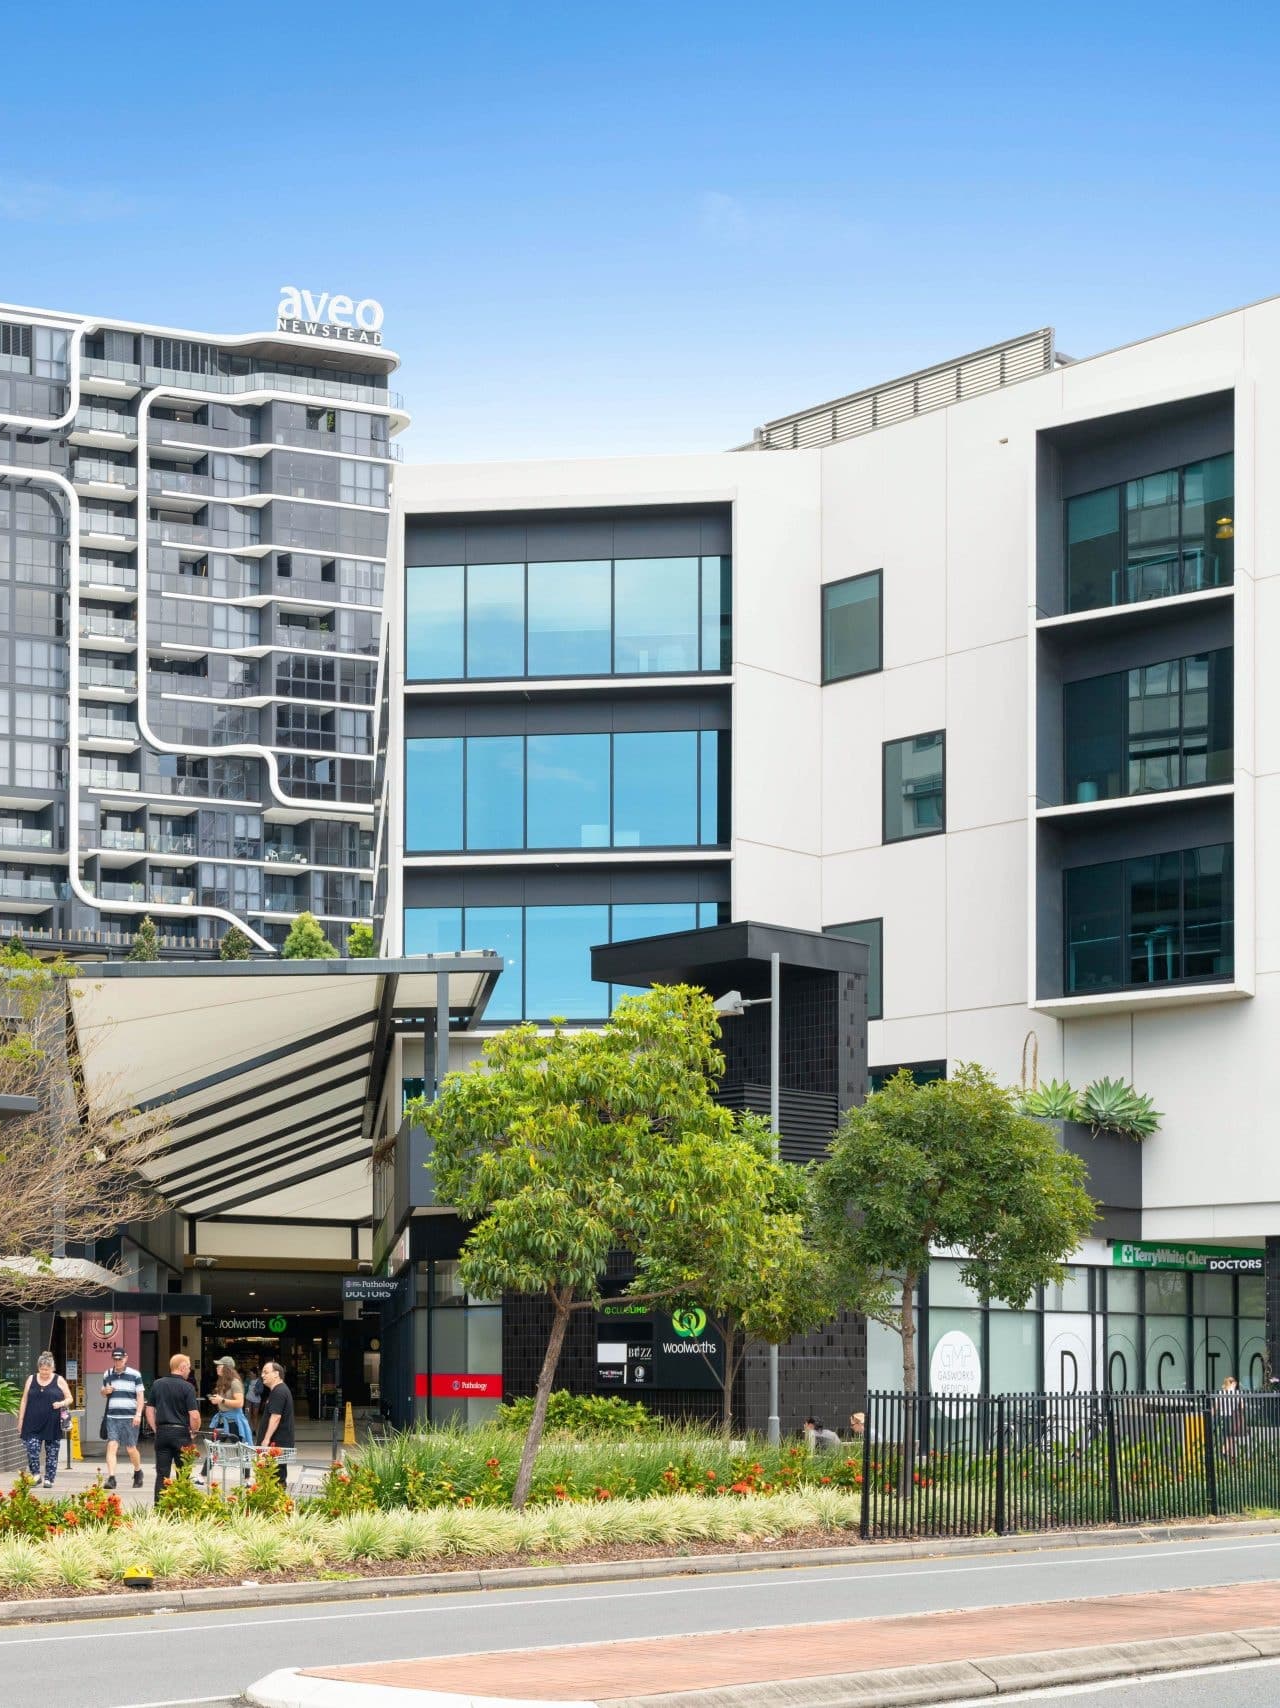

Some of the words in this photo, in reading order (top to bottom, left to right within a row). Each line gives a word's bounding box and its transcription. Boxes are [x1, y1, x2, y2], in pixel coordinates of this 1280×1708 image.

[277, 286, 385, 333] aveo
[277, 319, 384, 345] NEWSTEAD
[1210, 1259, 1263, 1270] DOCTORS
[362, 1280, 399, 1290] Pathology
